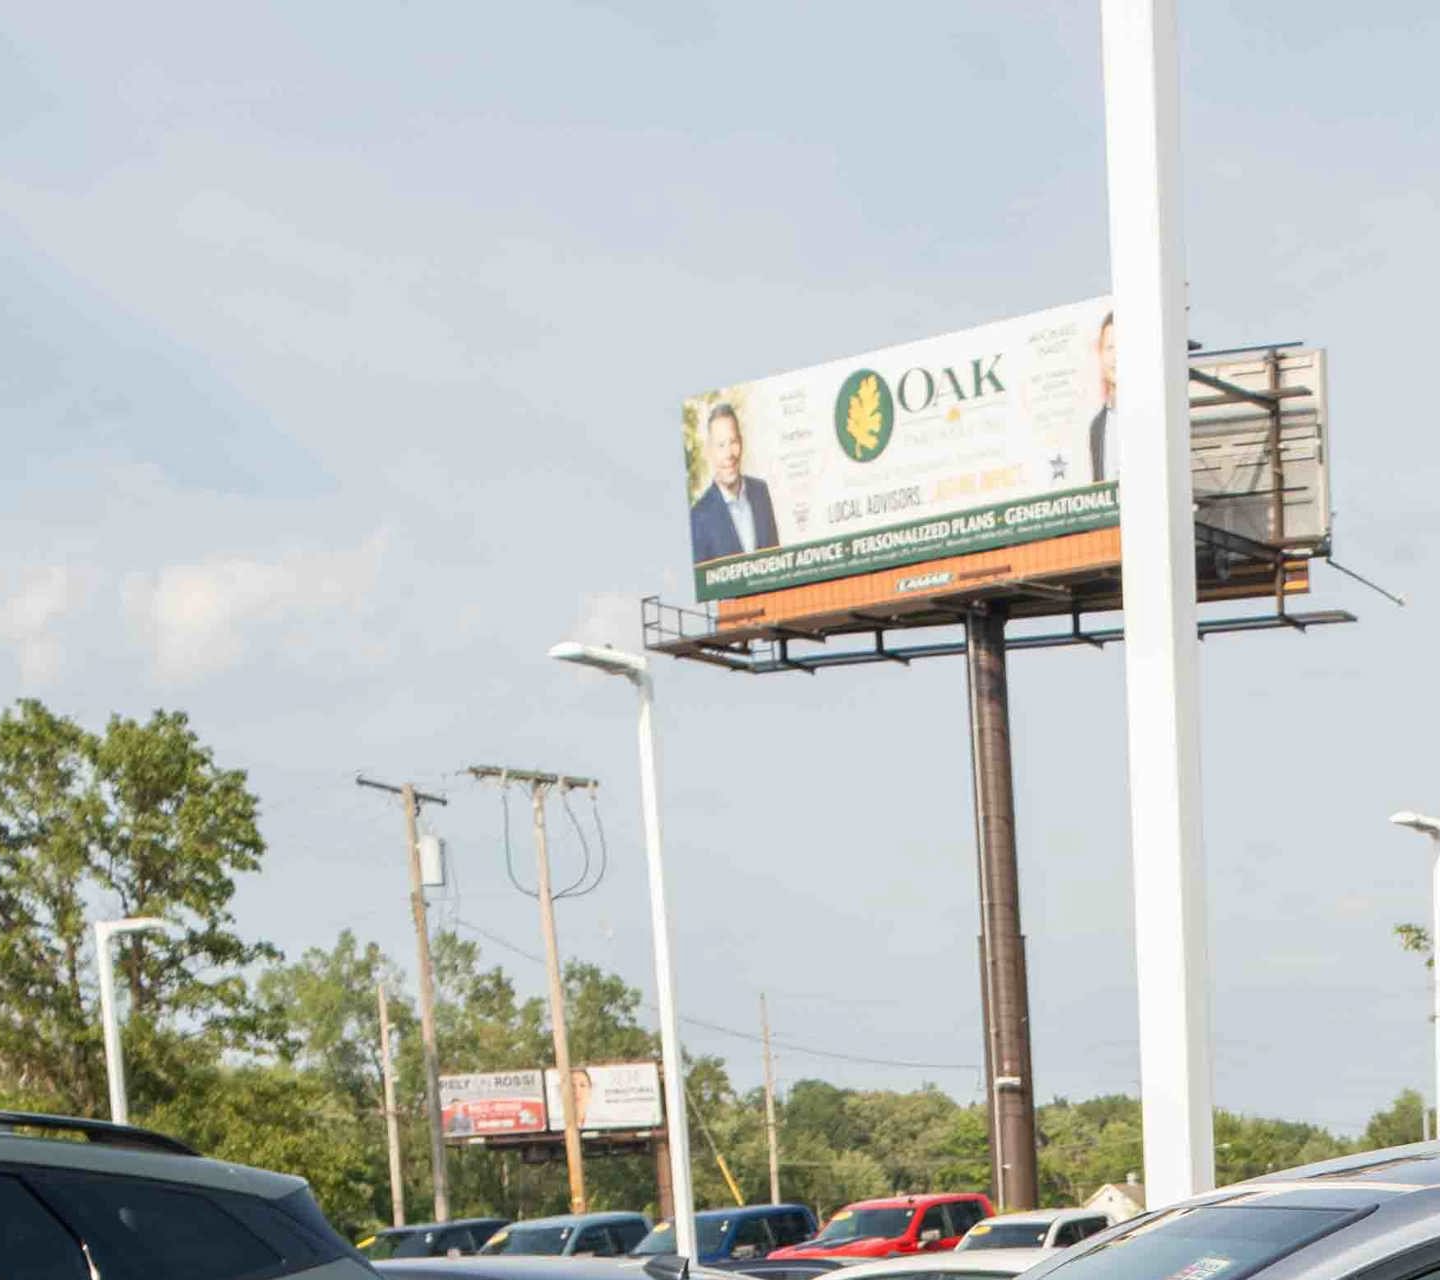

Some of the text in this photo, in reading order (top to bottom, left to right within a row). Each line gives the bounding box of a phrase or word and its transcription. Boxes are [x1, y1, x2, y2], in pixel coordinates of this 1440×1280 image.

[897, 353, 1006, 413] OAK
[705, 552, 794, 586] INDEPENDENT
[795, 541, 844, 567] ADVICE
[851, 521, 951, 556] PERSONALIZED
[951, 510, 996, 536] PLANS
[1004, 490, 1115, 526] GENERATIONAL
[827, 498, 862, 524] LOCAL
